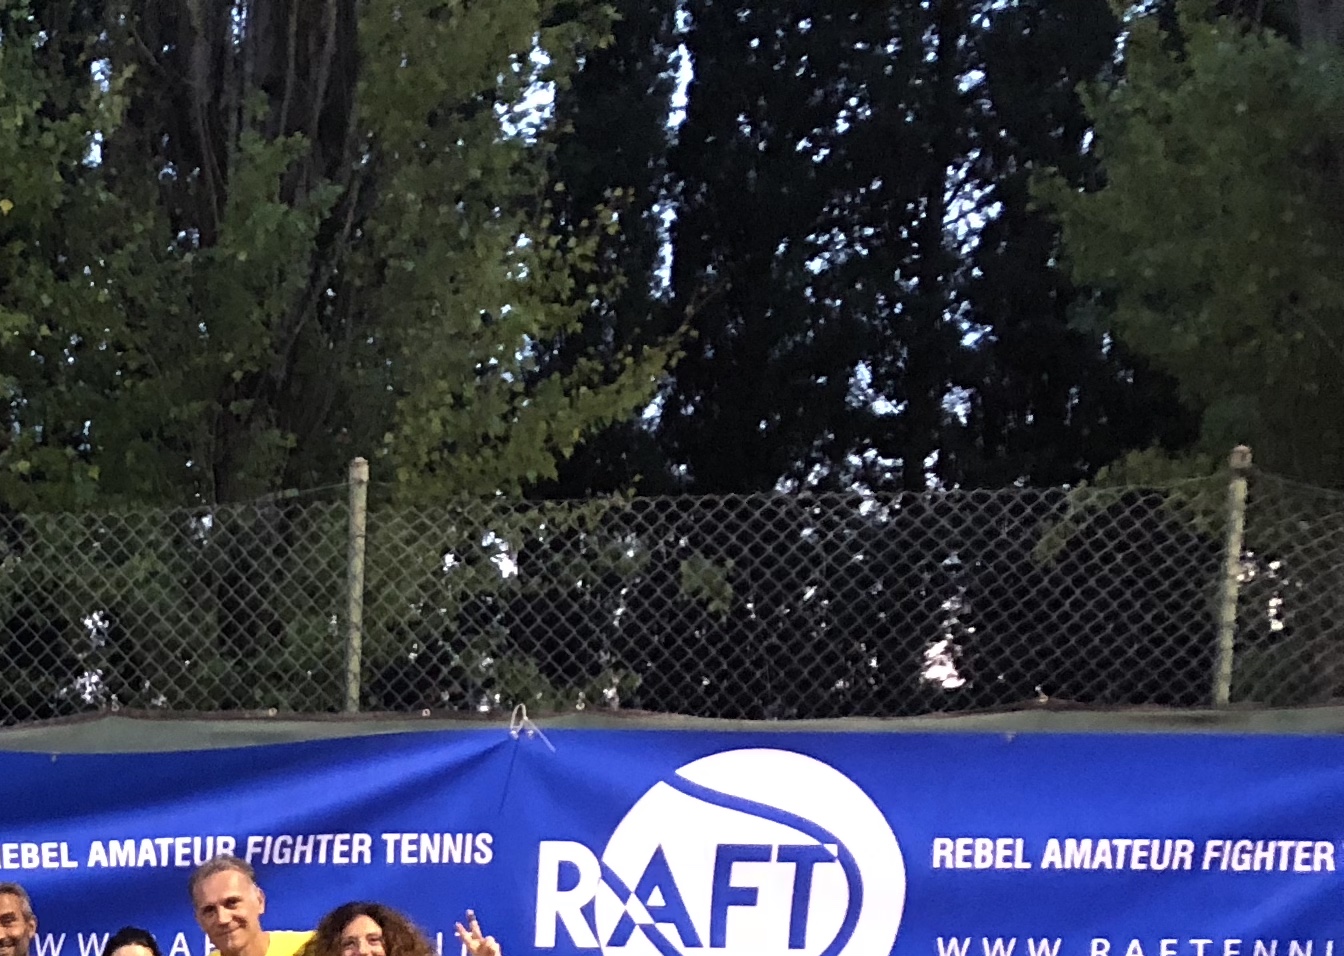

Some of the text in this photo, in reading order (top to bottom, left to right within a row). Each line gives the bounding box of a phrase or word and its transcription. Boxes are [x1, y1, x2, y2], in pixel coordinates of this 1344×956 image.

[245, 834, 372, 865] FIGHTER
[381, 832, 493, 865] TENNIS
[932, 837, 1336, 872] REBEL AMATEUR FIGHTER
